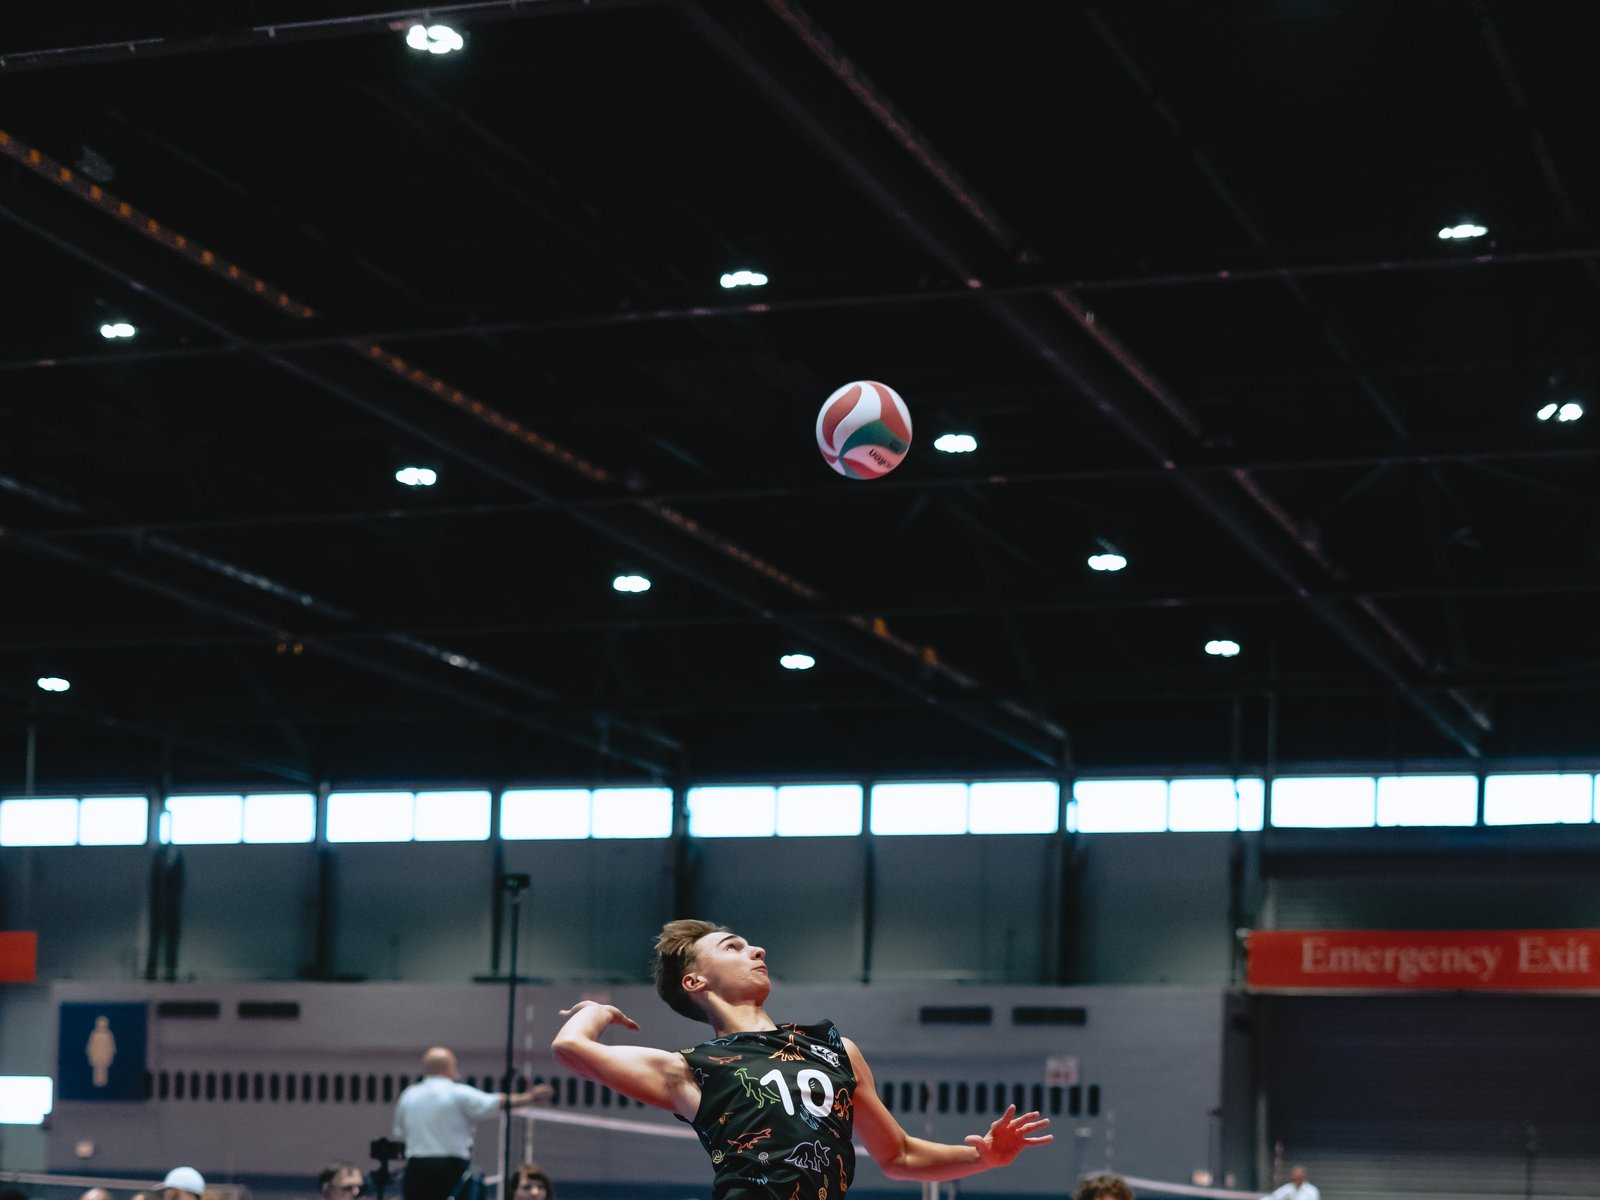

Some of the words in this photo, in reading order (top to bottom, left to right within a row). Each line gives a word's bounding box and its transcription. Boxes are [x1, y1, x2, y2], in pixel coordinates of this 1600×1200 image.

[1301, 937, 1501, 982] Emergency
[1517, 936, 1592, 974] Exit
[759, 1069, 834, 1118] 10
